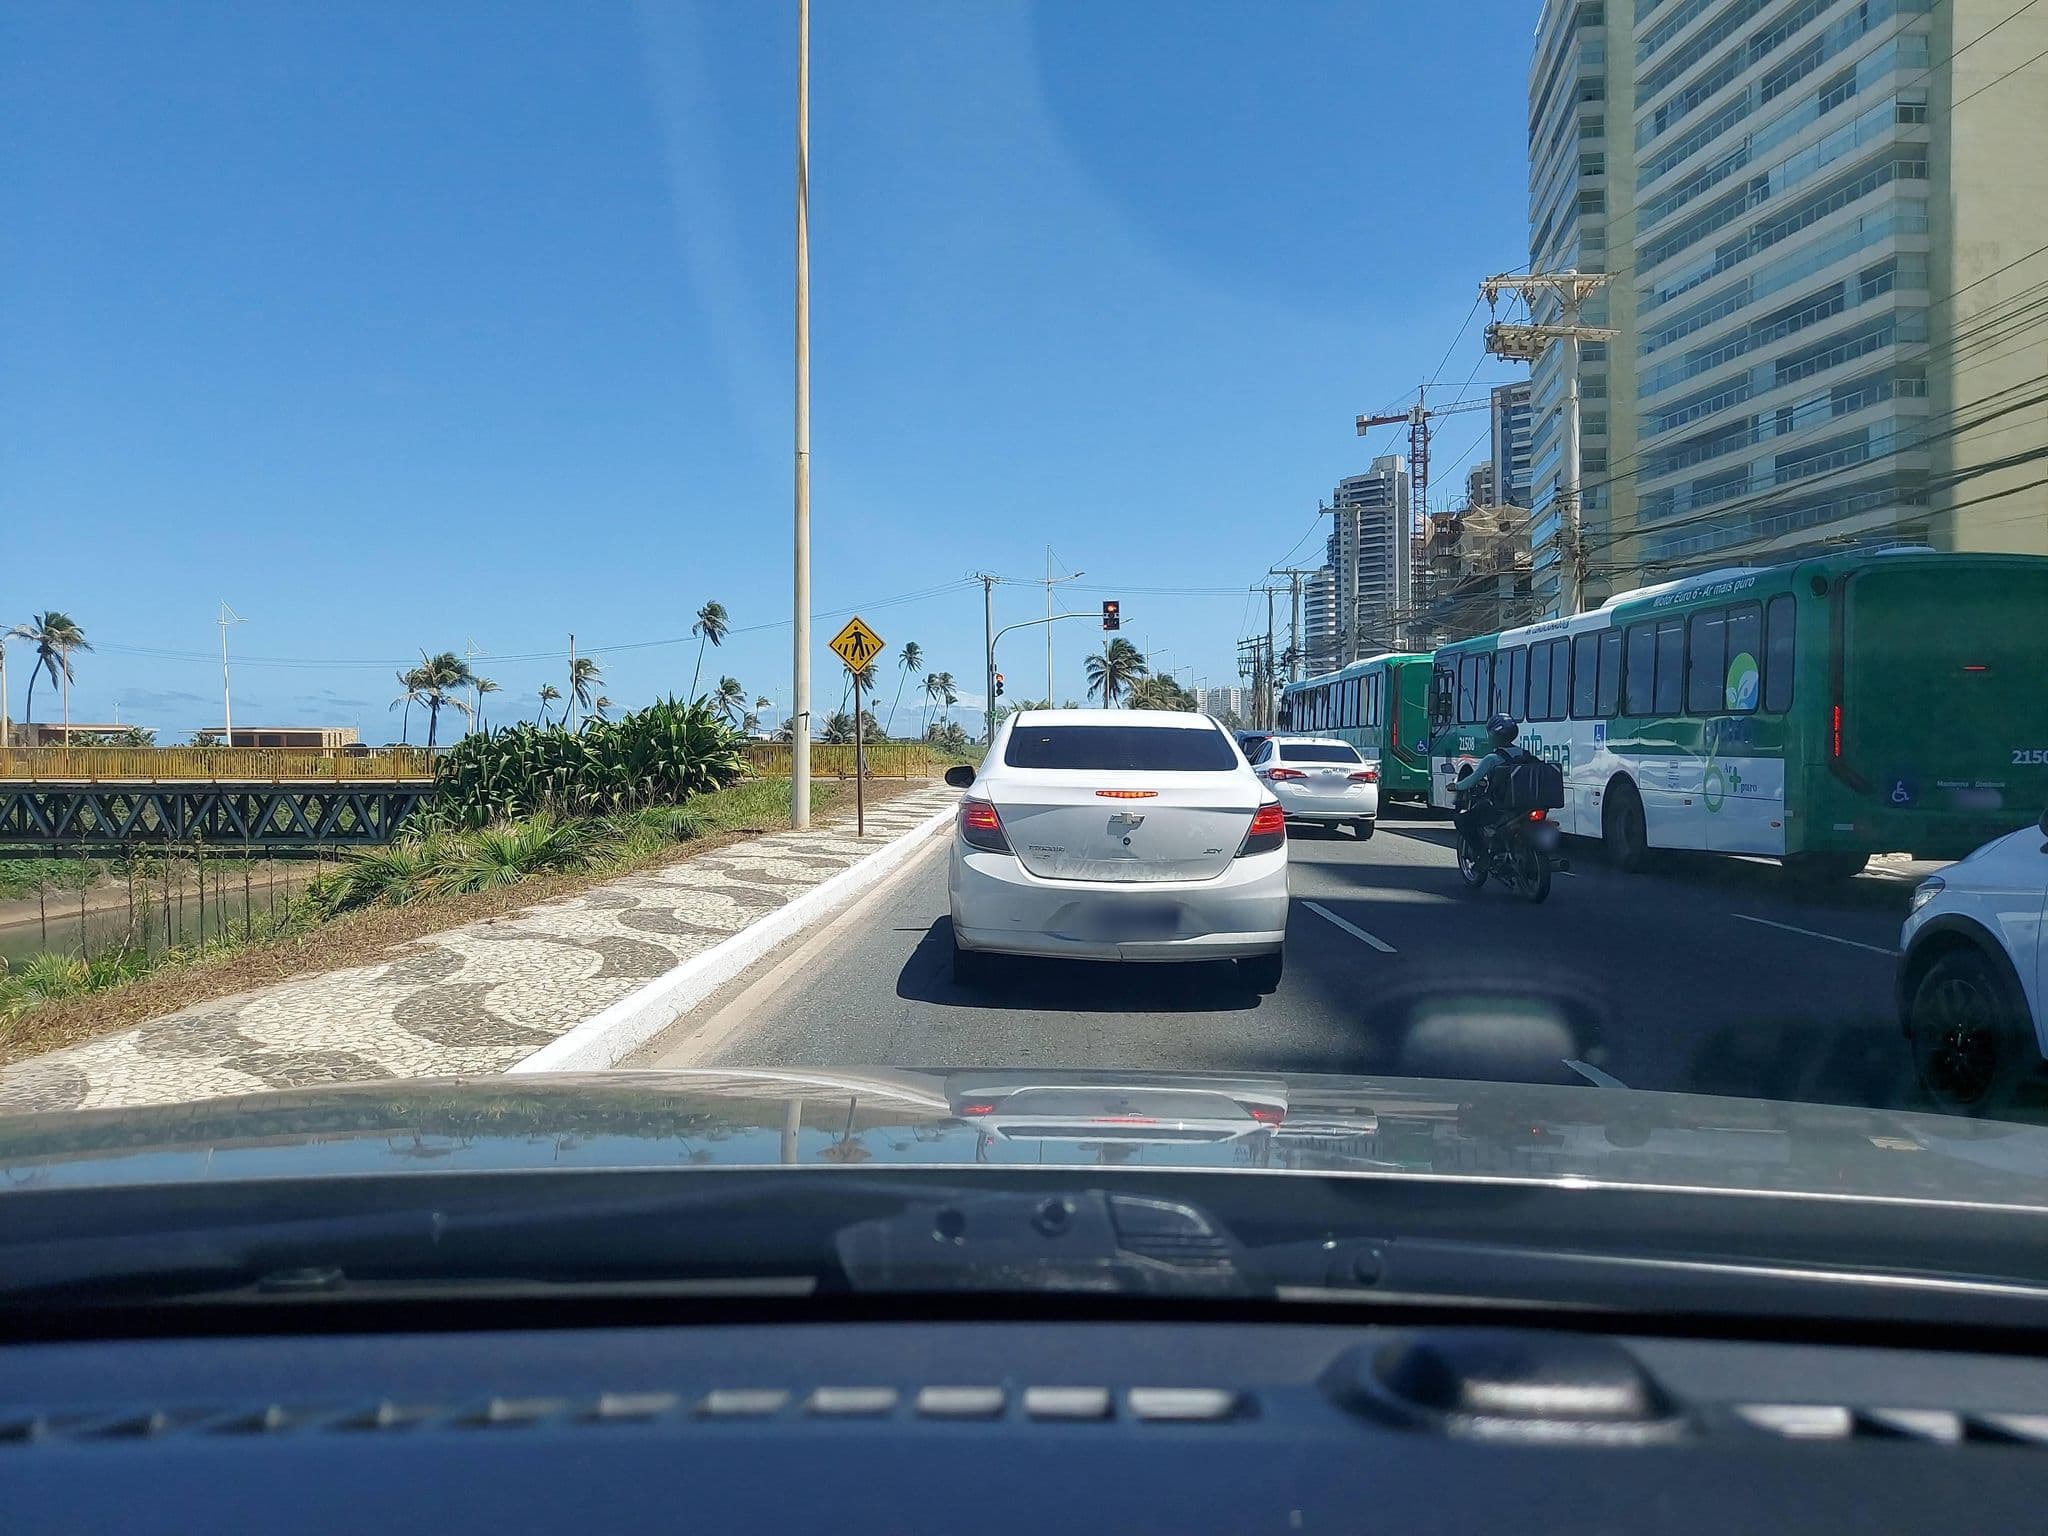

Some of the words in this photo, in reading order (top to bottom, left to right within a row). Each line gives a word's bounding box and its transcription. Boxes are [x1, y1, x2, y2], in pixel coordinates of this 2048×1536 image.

[1674, 591, 1693, 602] Euro
[1702, 584, 1714, 597] Ar
[1714, 581, 1734, 595] mais
[1734, 577, 1755, 593] puro
[1723, 763, 1732, 774] Ar
[1740, 783, 1758, 793] puro
